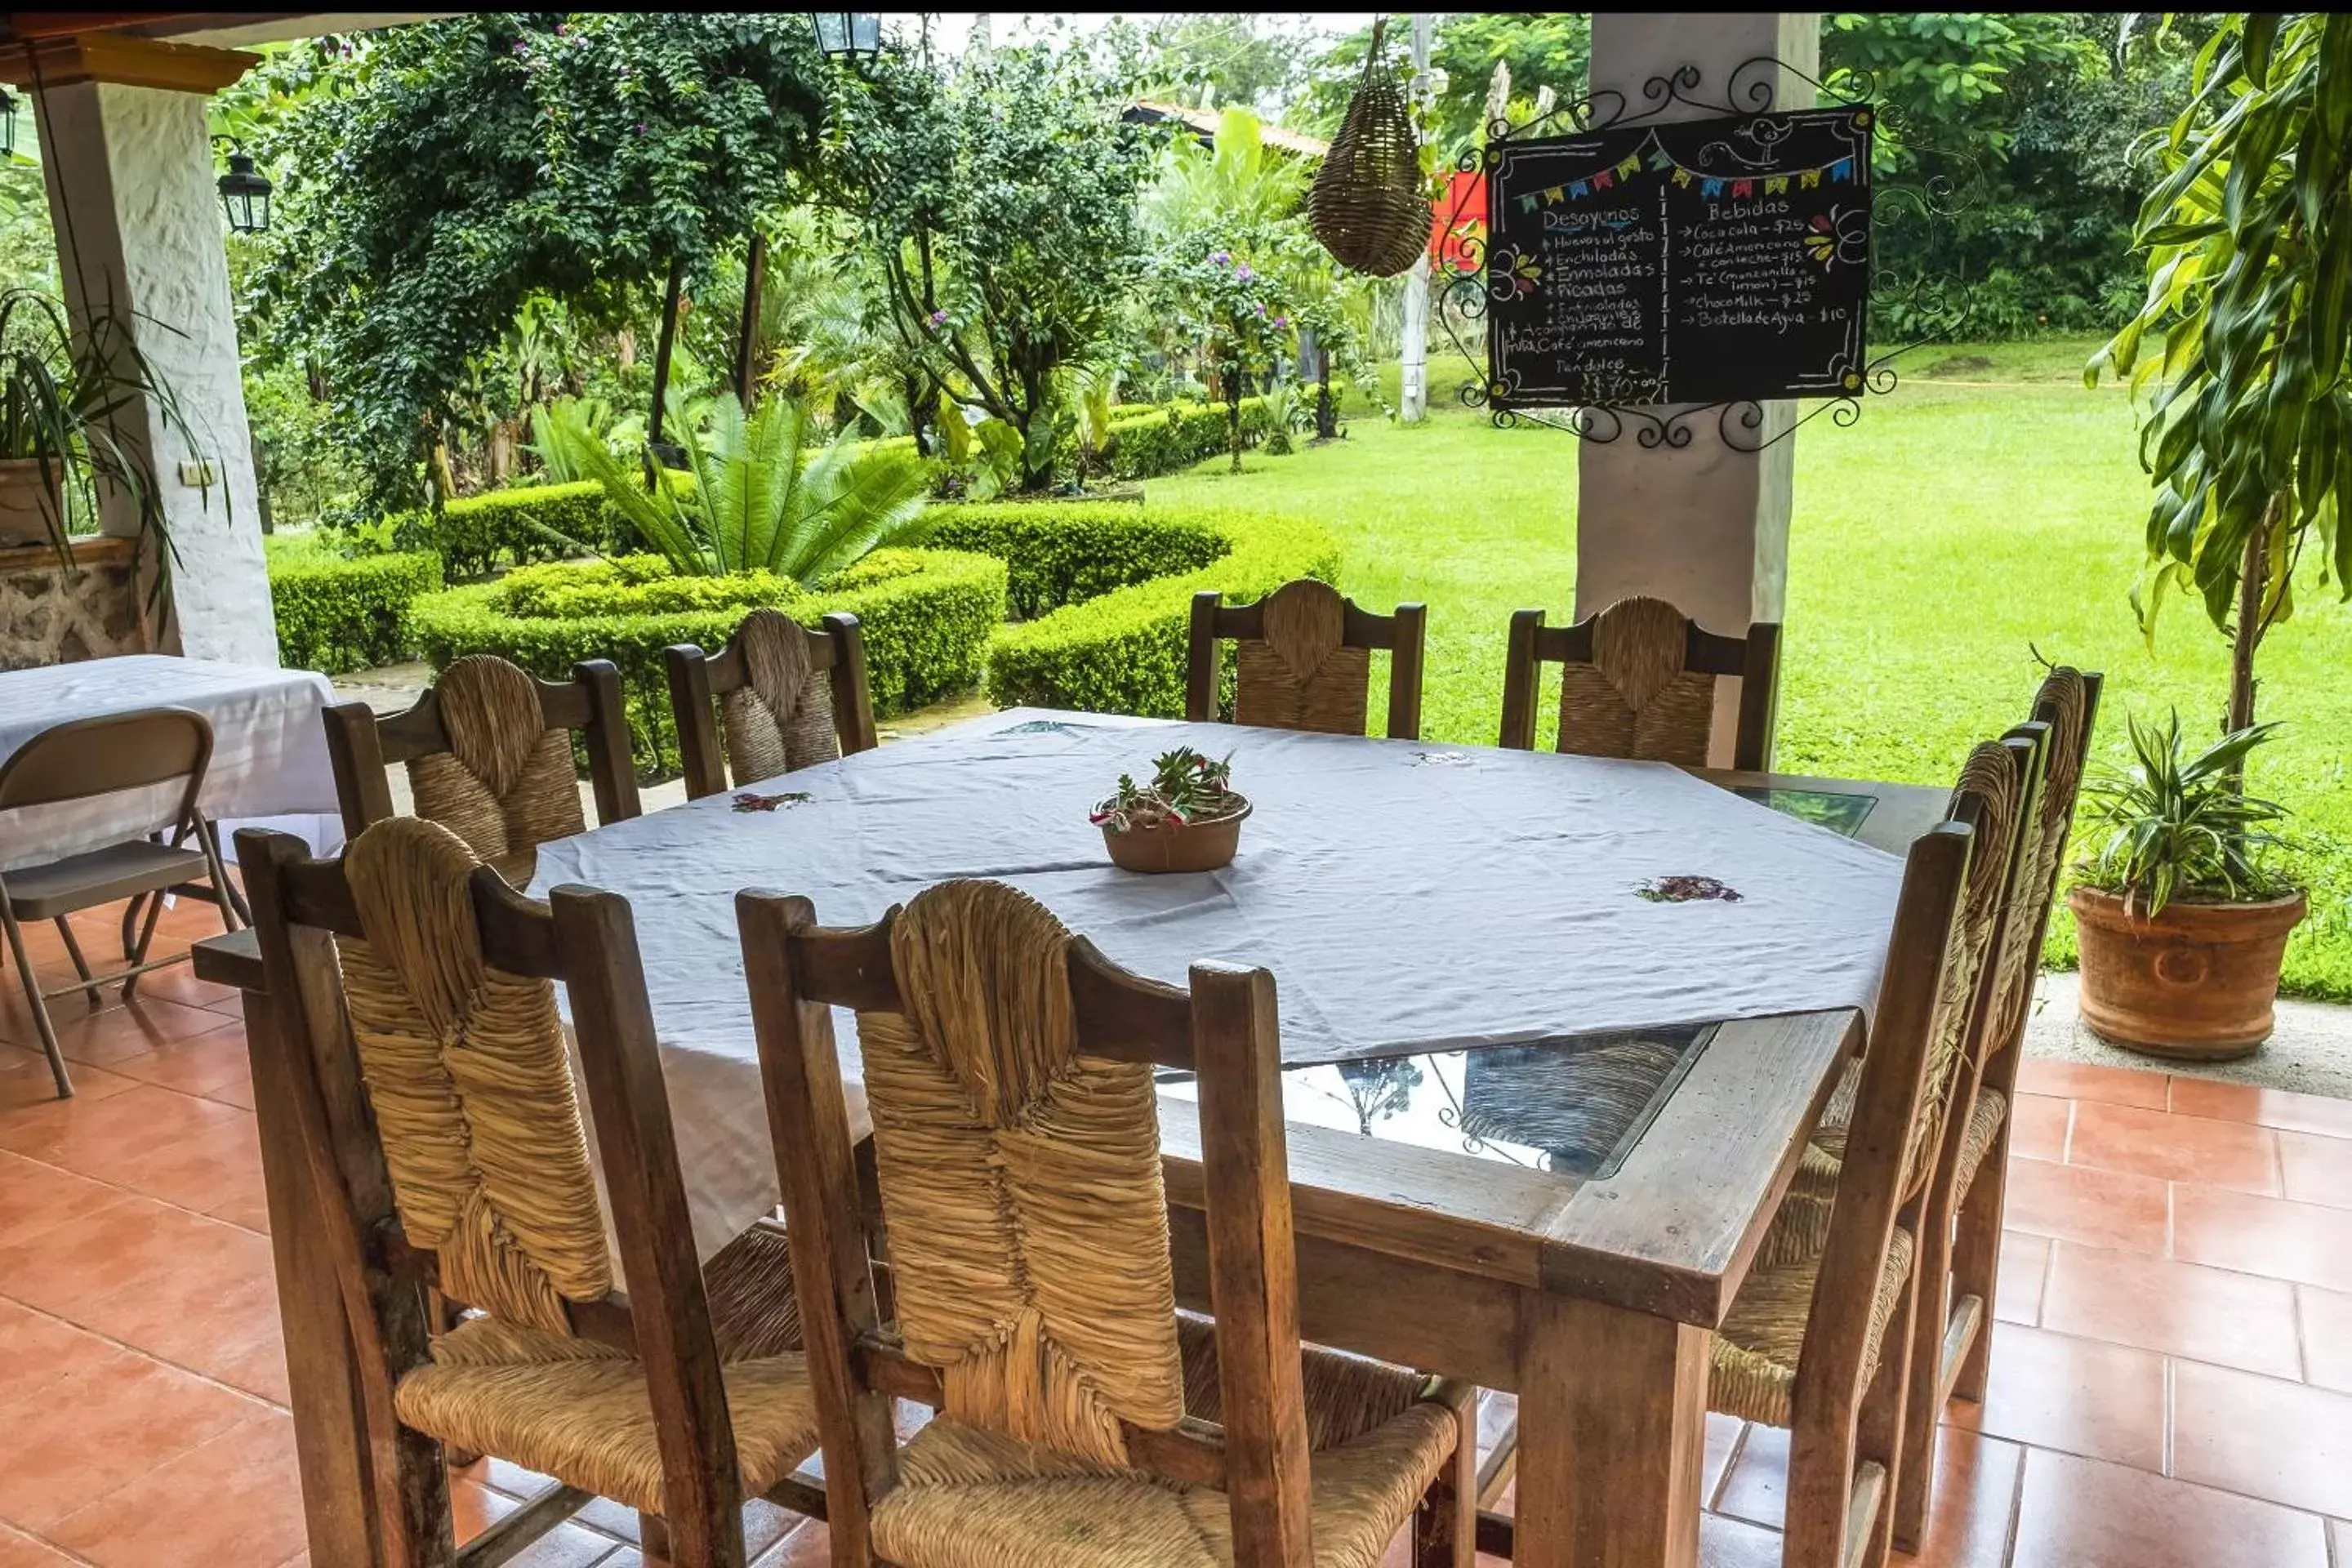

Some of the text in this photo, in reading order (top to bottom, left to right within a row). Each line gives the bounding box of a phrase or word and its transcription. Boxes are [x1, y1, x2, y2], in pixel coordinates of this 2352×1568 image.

[1543, 207, 1640, 230] Desayunos
[1708, 199, 1790, 221] Bebidas
[1556, 247, 1638, 266] Enchiladas
[1556, 262, 1655, 283] Enmoladas
[1557, 282, 1628, 298] Picadas
[1584, 357, 1626, 373] dulce
